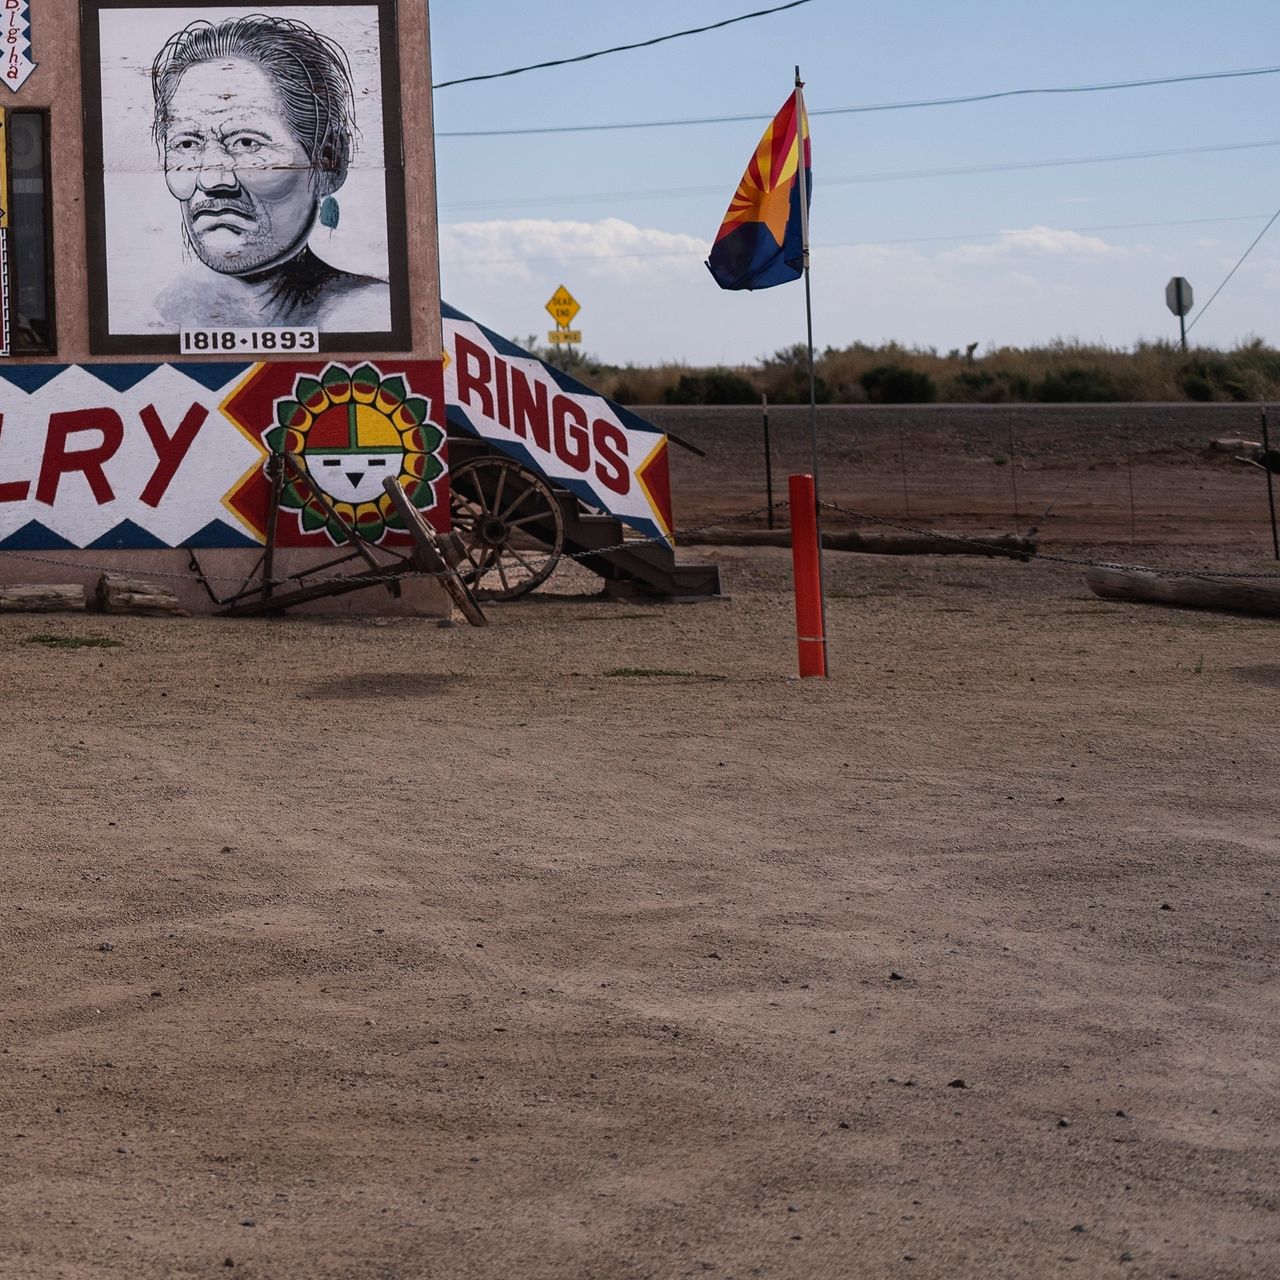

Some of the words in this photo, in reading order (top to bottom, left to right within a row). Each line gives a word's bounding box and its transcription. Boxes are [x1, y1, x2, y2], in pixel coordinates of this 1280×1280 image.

[553, 297, 573, 306] DEAD
[556, 309, 569, 317] END
[454, 332, 630, 496] RINGS
